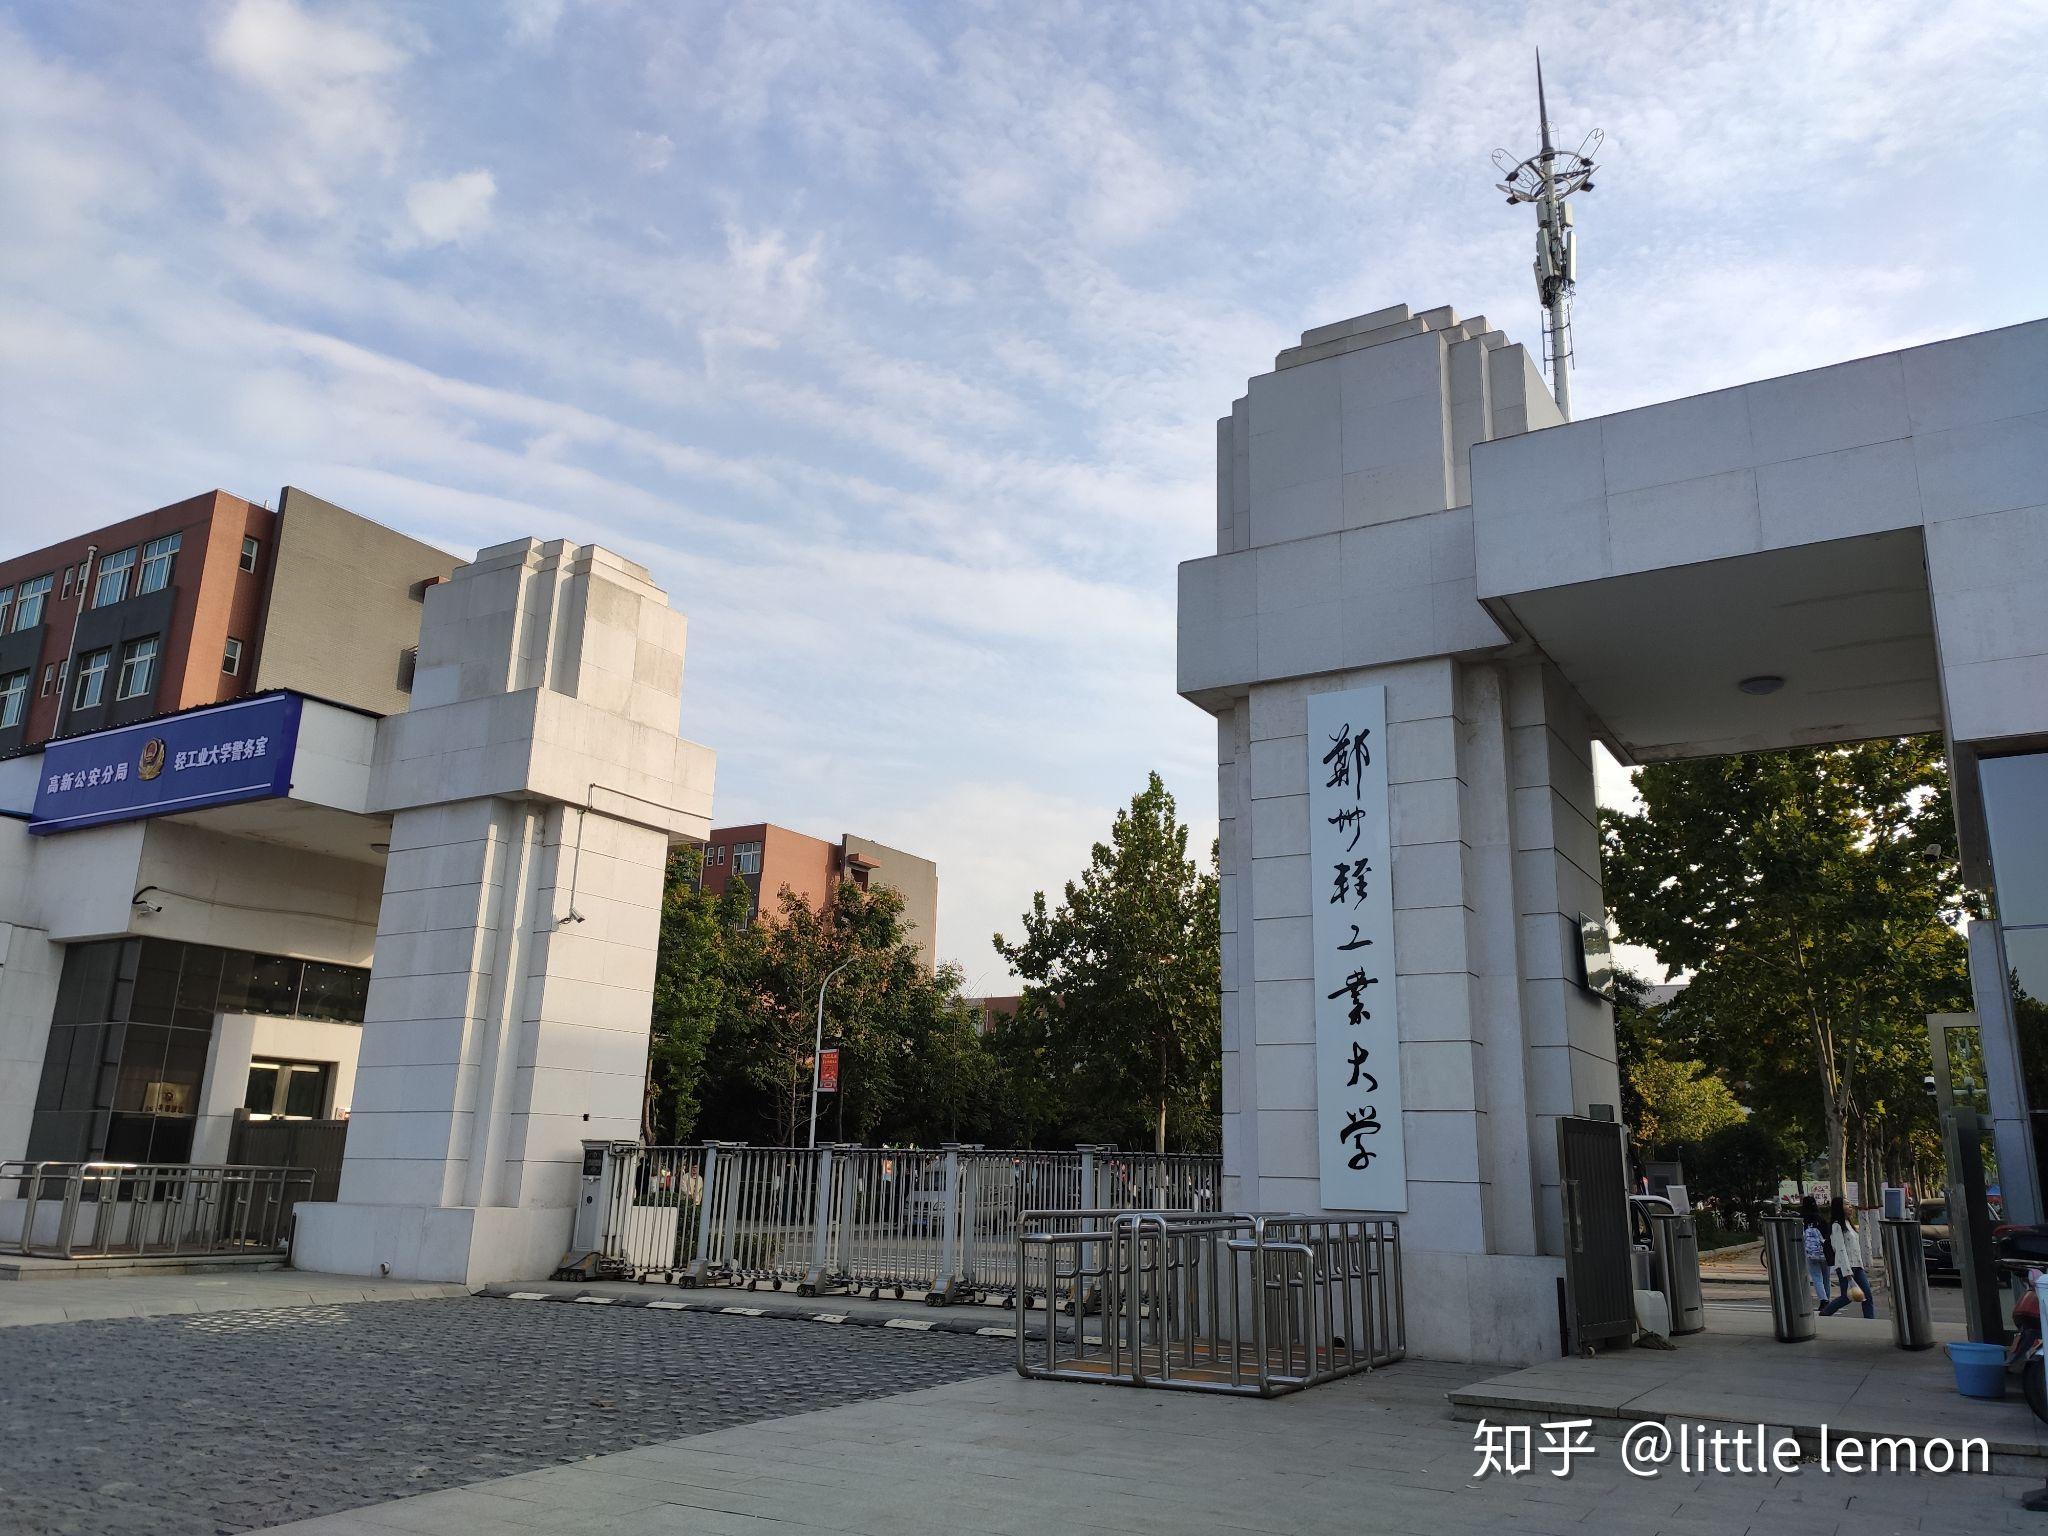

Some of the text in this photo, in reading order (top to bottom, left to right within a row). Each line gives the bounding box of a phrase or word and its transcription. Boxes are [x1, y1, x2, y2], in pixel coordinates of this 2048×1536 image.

[47, 736, 268, 795] 高新公安分局 轻工业大学警务室
